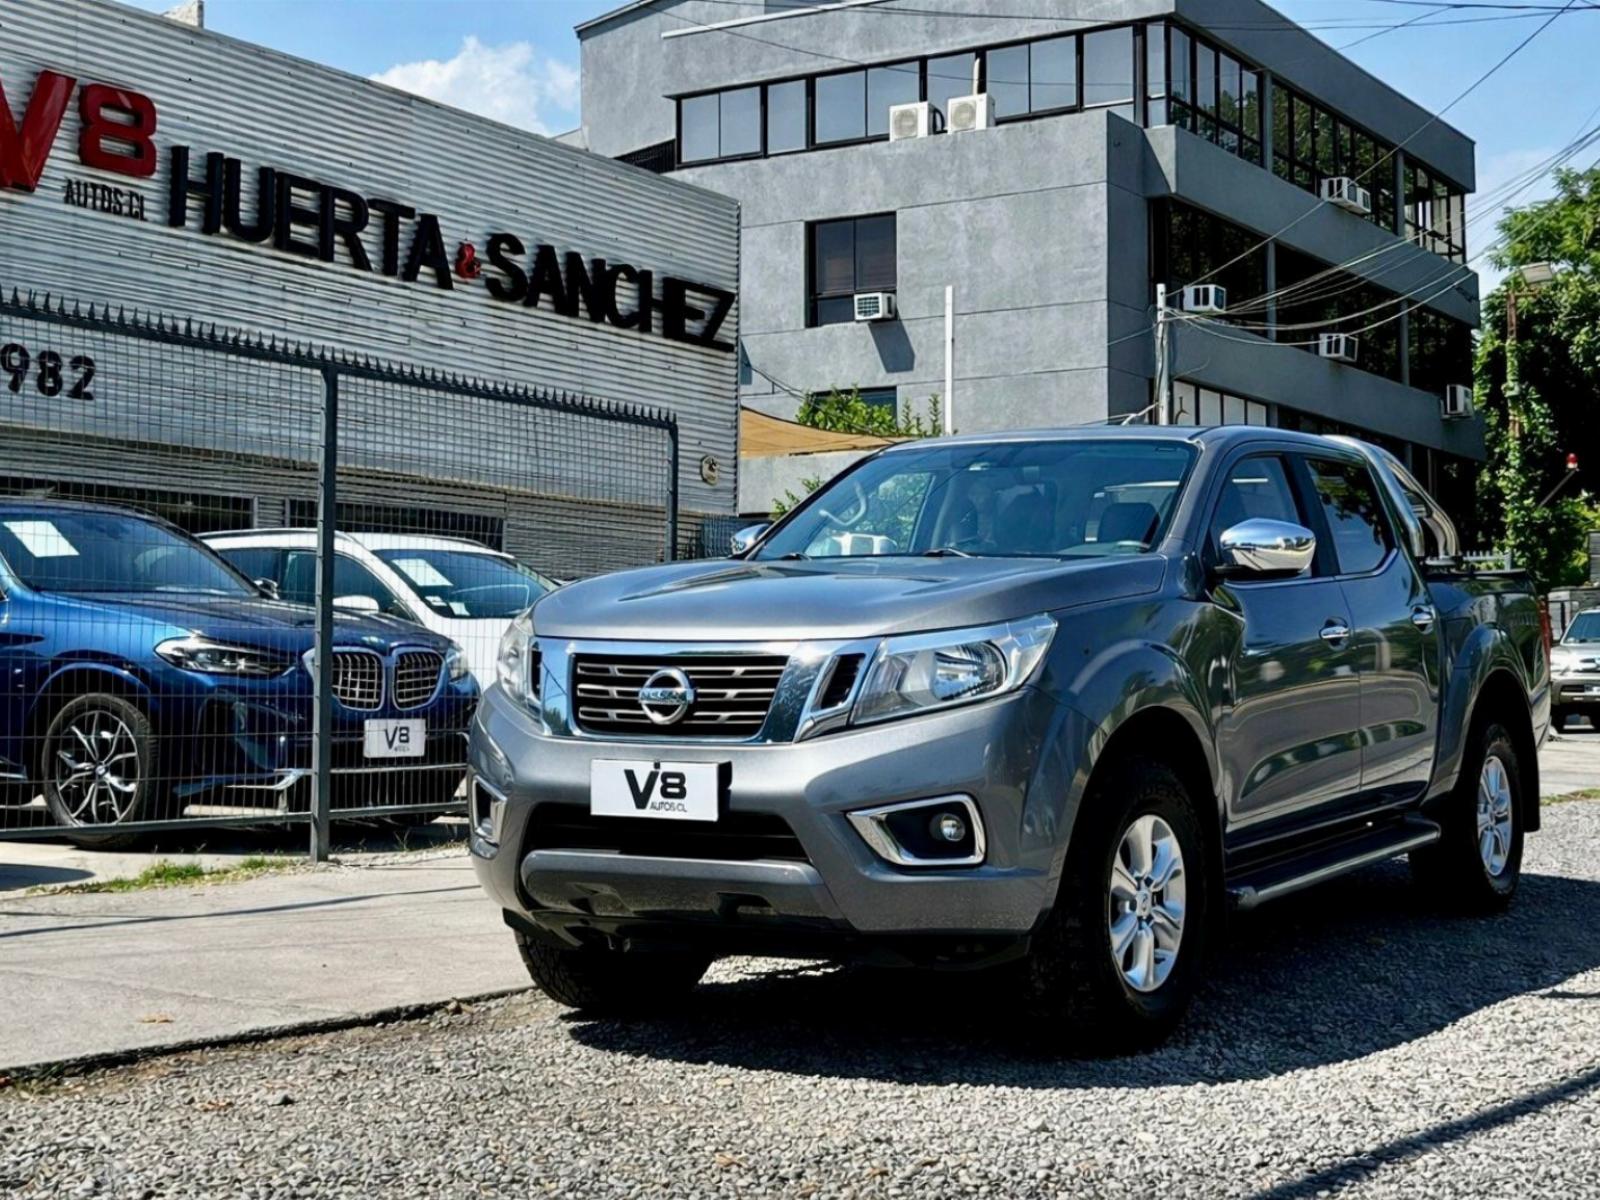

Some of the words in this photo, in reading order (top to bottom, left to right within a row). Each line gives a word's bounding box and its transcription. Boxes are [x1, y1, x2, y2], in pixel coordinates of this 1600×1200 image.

[168, 145, 453, 289] HUERTA
[455, 242, 480, 279] &
[485, 232, 737, 352] SANCHEZ
[0, 343, 96, 400] 982
[384, 726, 410, 750] V8
[624, 769, 687, 810] V8
